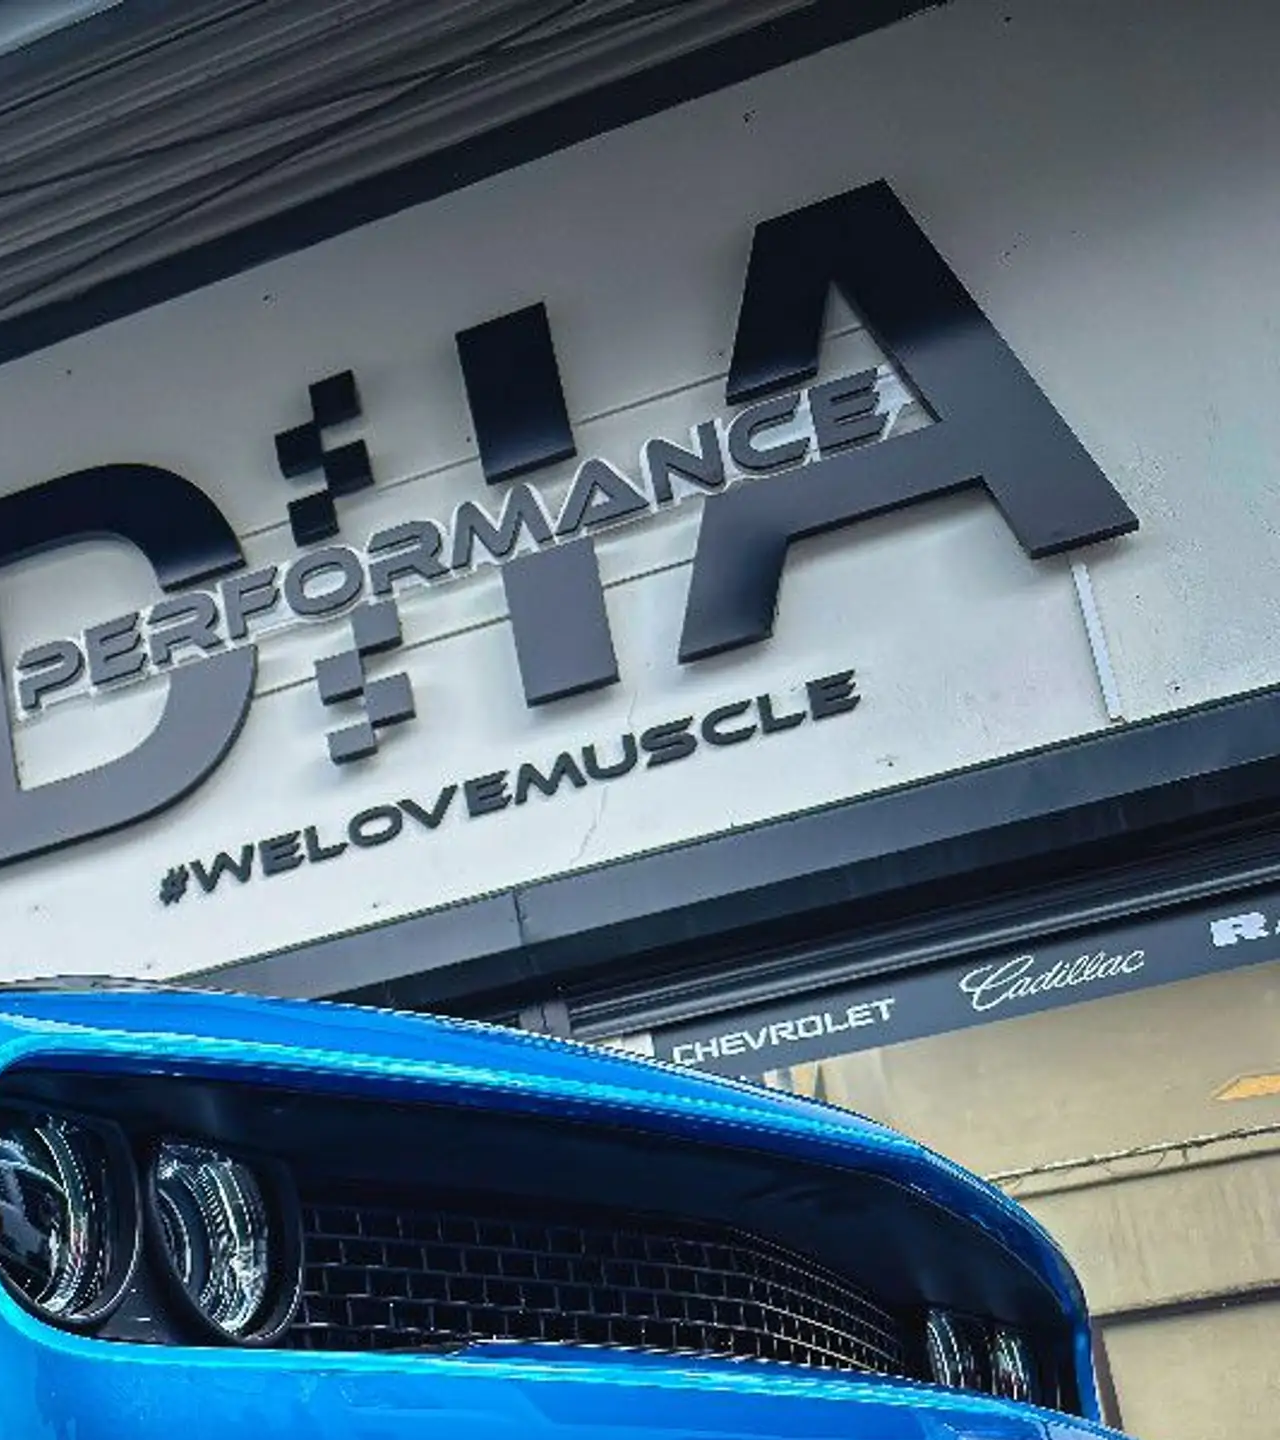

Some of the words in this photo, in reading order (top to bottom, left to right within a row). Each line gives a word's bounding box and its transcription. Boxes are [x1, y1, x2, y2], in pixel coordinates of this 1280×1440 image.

[16, 368, 889, 711] PERFORMANCE
[159, 669, 861, 906] #WELOVEMUSCLE
[674, 998, 895, 1067] CHEVROLET
[959, 951, 1145, 1012] Cadillac
